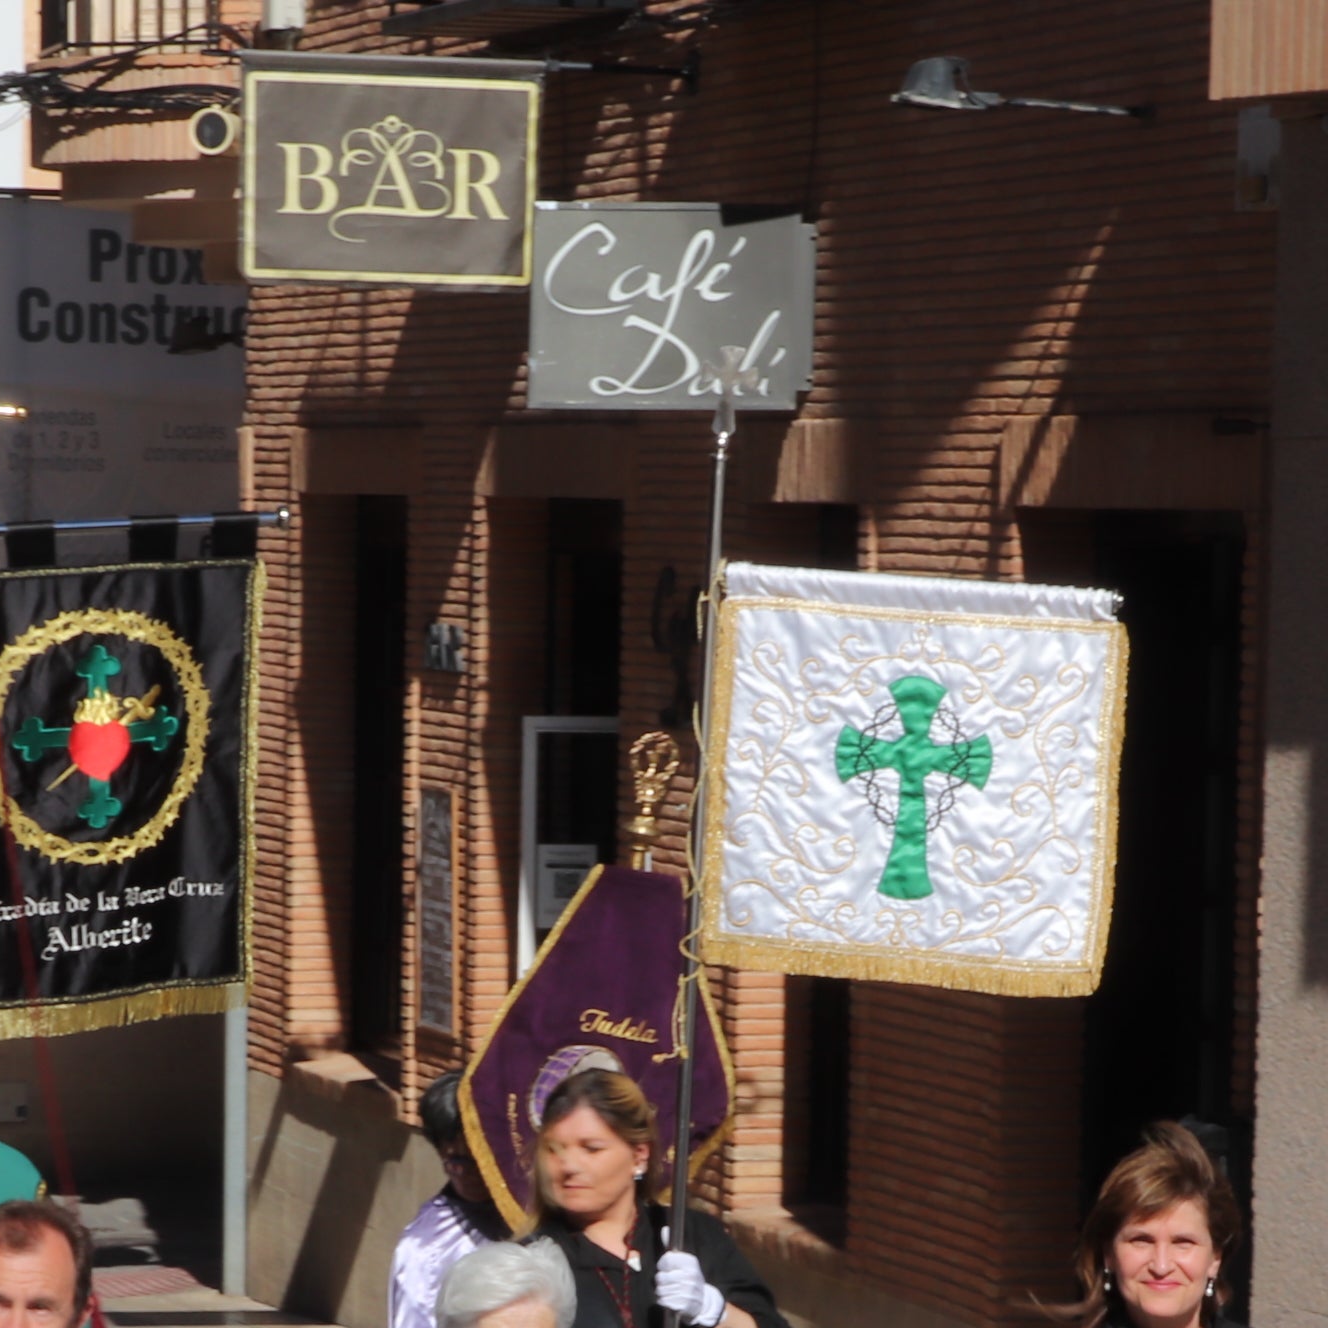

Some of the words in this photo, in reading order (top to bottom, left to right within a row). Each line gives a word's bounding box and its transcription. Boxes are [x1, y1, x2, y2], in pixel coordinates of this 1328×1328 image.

[276, 125, 510, 236] BAR
[543, 222, 747, 318] Café
[65, 891, 92, 914] de
[97, 891, 121, 912] la
[168, 876, 224, 899] Cruz
[40, 917, 154, 961] Alberite
